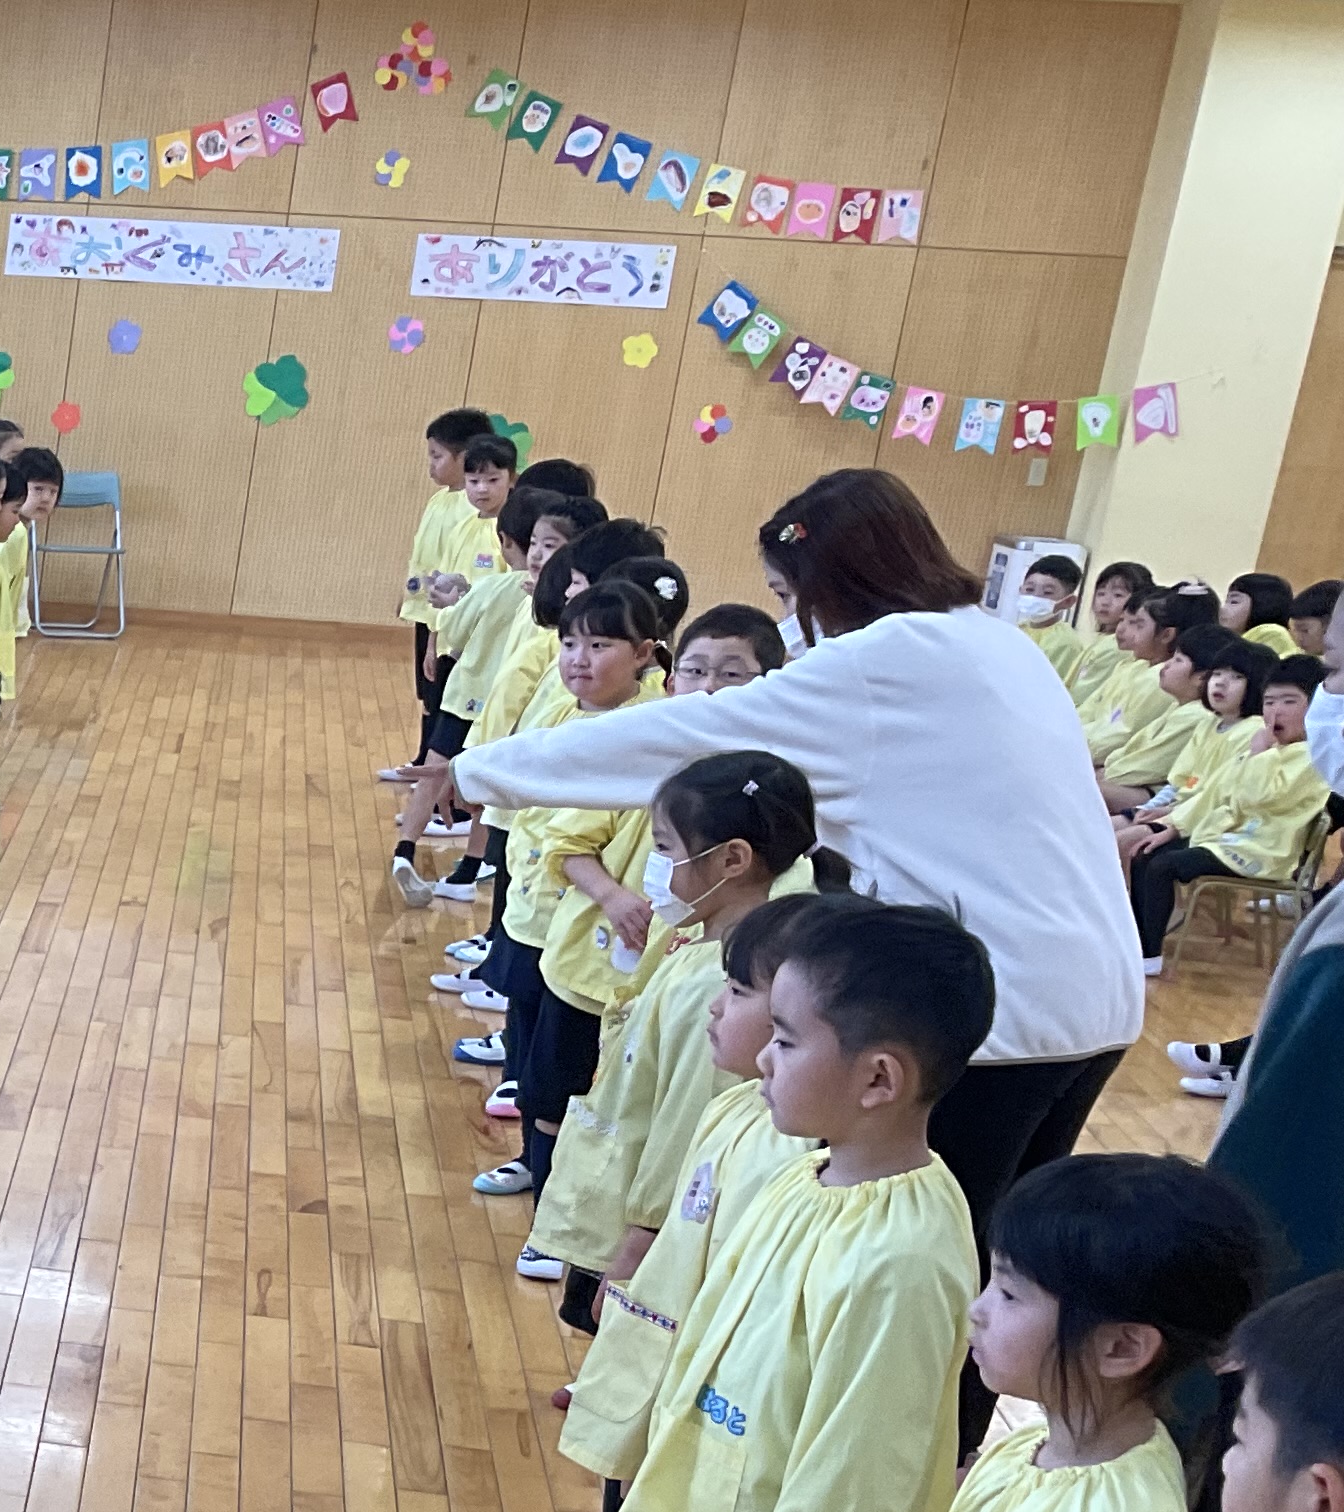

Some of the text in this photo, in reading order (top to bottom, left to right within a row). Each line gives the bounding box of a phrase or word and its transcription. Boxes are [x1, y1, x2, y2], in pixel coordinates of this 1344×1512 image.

[428, 242, 645, 298] ありがとう
[695, 1382, 747, 1437] はると
